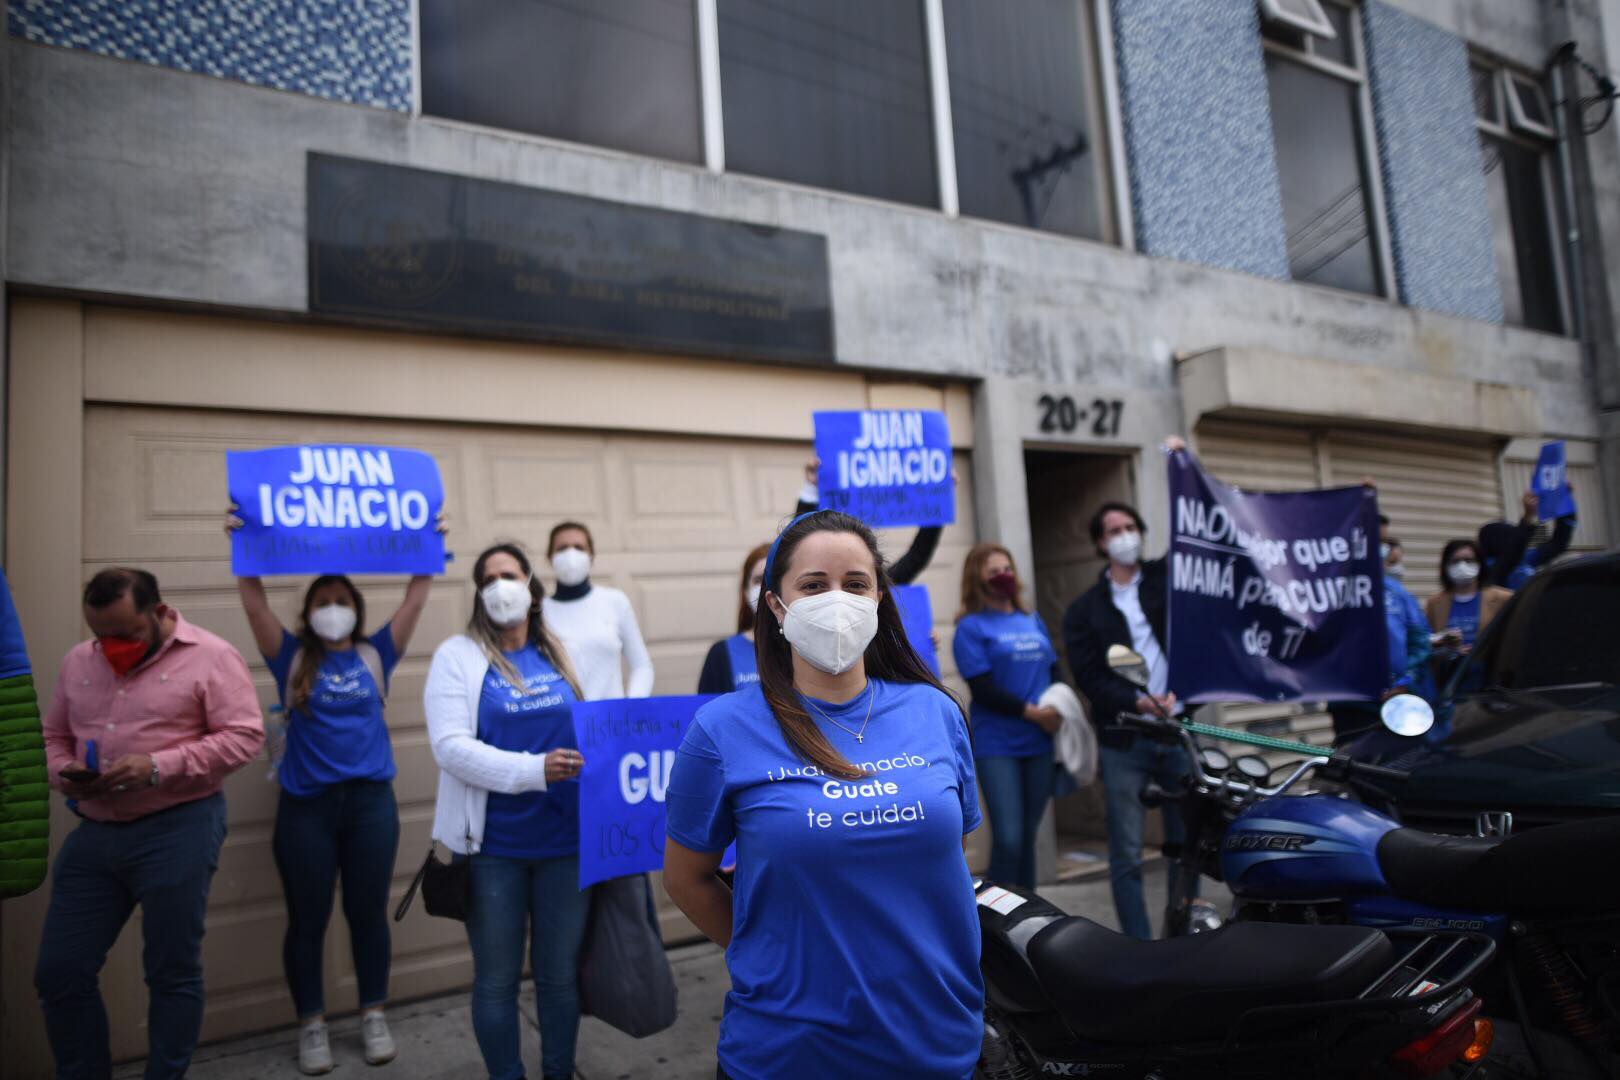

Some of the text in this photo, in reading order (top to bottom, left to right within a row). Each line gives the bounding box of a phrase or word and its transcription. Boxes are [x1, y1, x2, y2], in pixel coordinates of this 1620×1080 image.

[854, 411, 925, 449] JUAN
[290, 446, 395, 487] JUAN
[838, 447, 948, 489] IGNACIO
[258, 483, 429, 531] IGNACIO
[1293, 536, 1349, 572] que
[1173, 552, 1235, 599] MAMÁ
[1242, 620, 1272, 657] de
[822, 779, 899, 799] Guate
[806, 800, 926, 828] te cuida!
